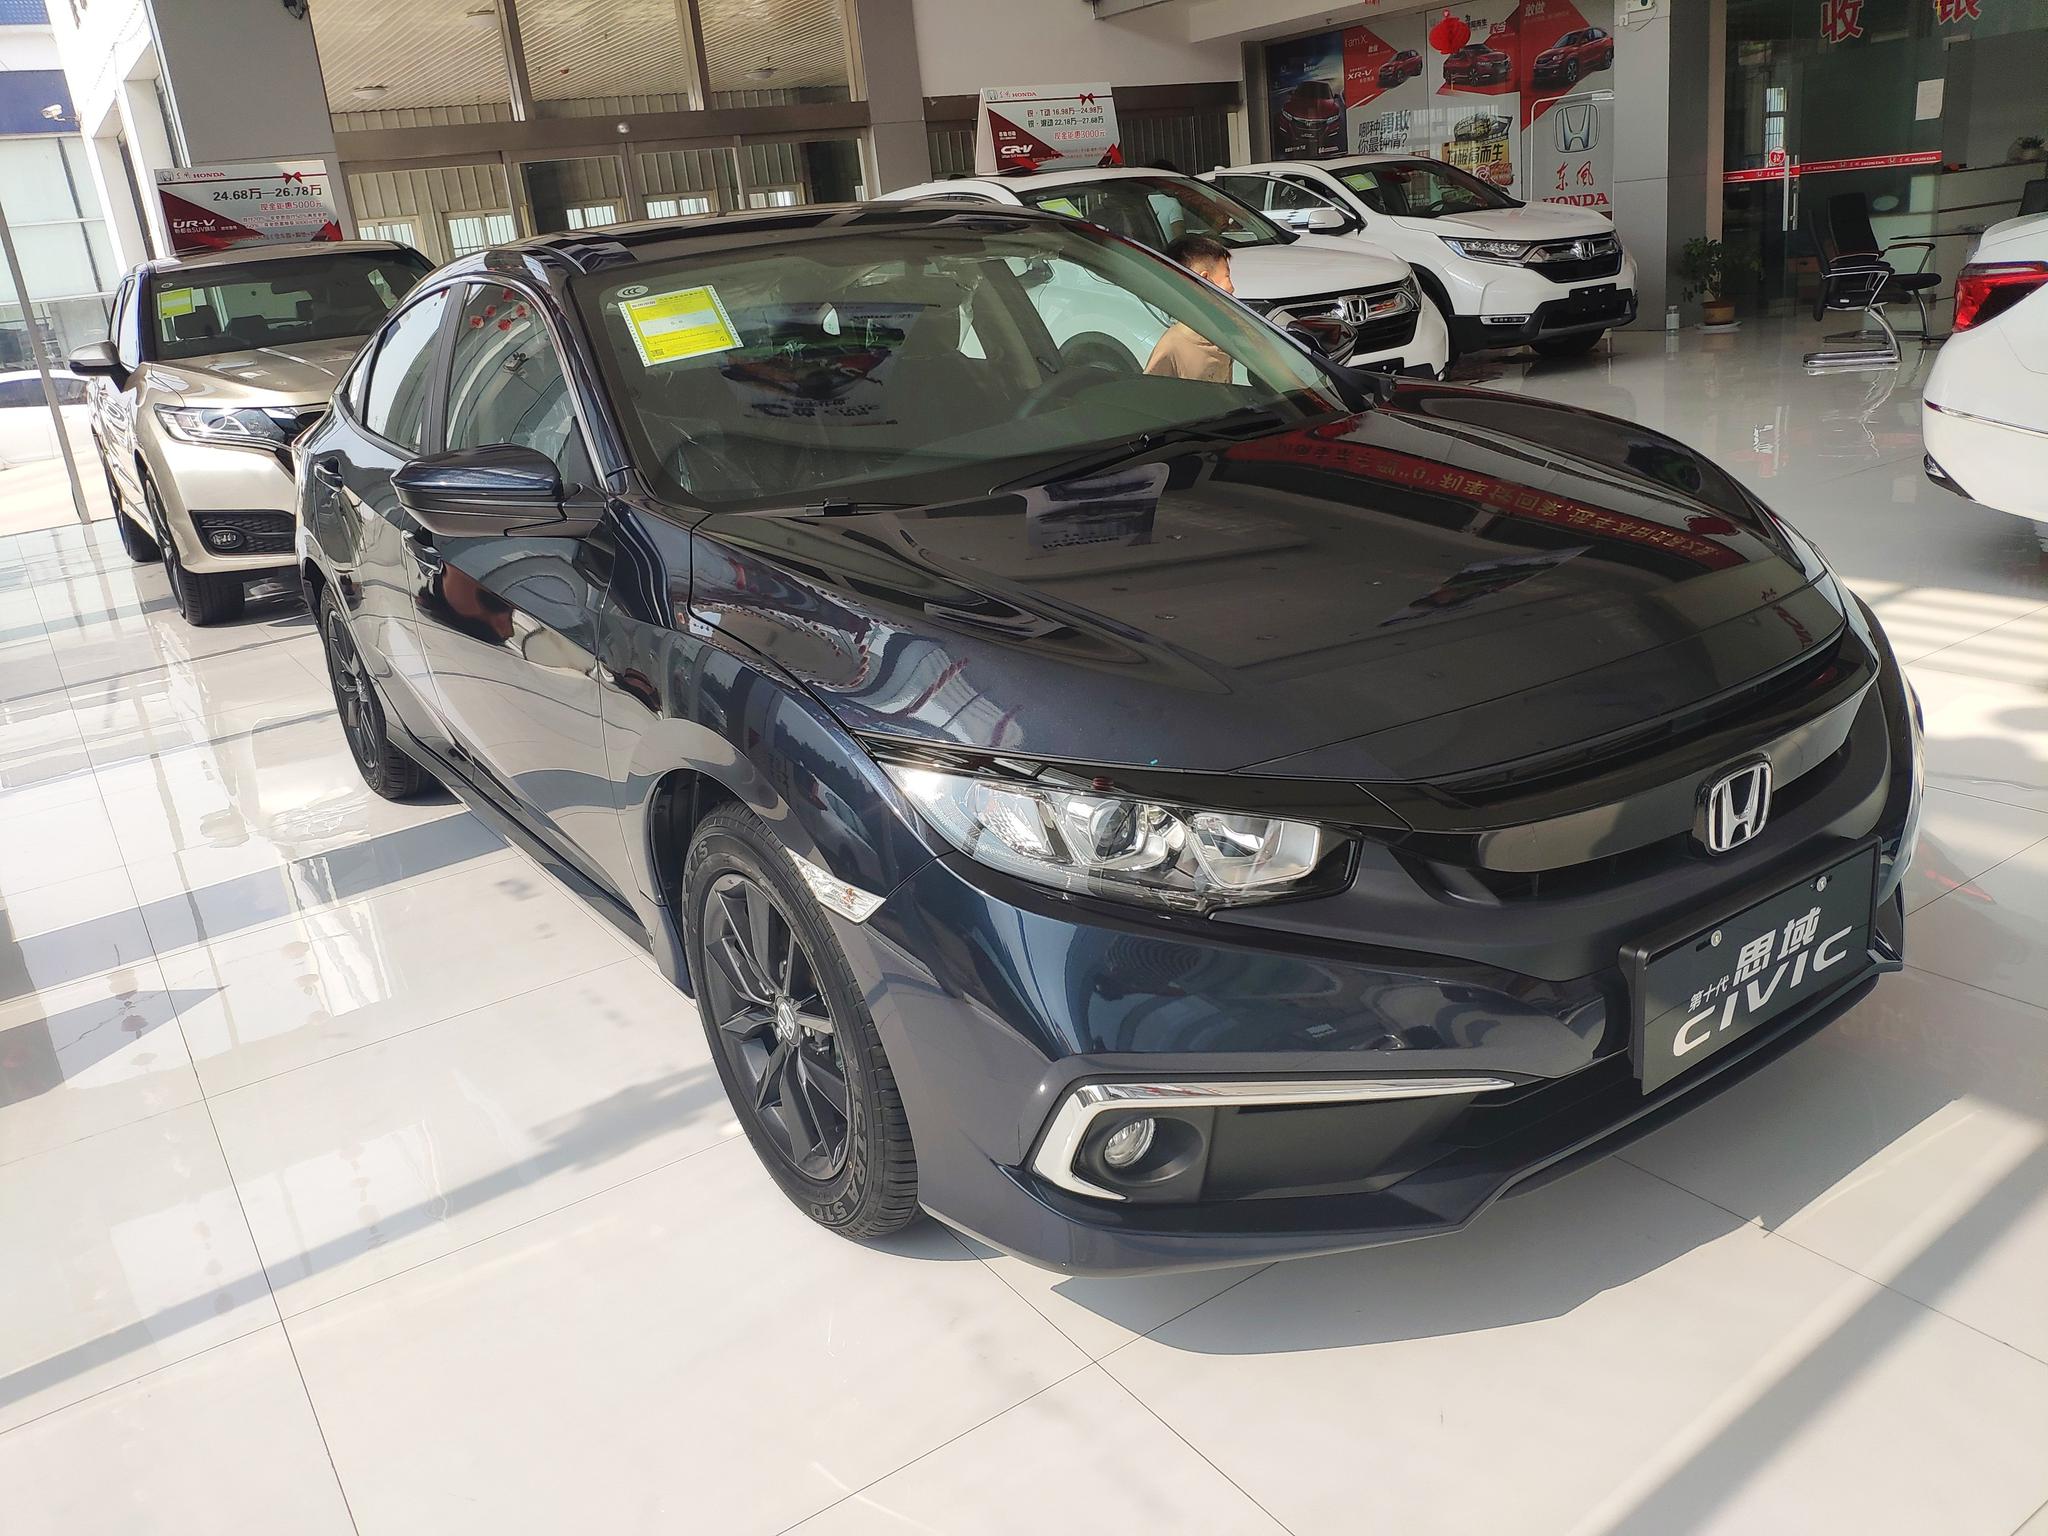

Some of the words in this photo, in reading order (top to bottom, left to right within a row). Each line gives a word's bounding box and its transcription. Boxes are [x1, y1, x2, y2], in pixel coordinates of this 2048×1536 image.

[1820, 0, 1863, 43] 收
[1000, 144, 1033, 154] CR-V
[193, 171, 226, 179] HONDA
[172, 218, 216, 230] UR-V
[1688, 975, 1730, 1013] 第十代
[1733, 906, 1822, 987] 思域
[1673, 926, 1852, 1057] CIVIC
[811, 1201, 848, 1223] 510
